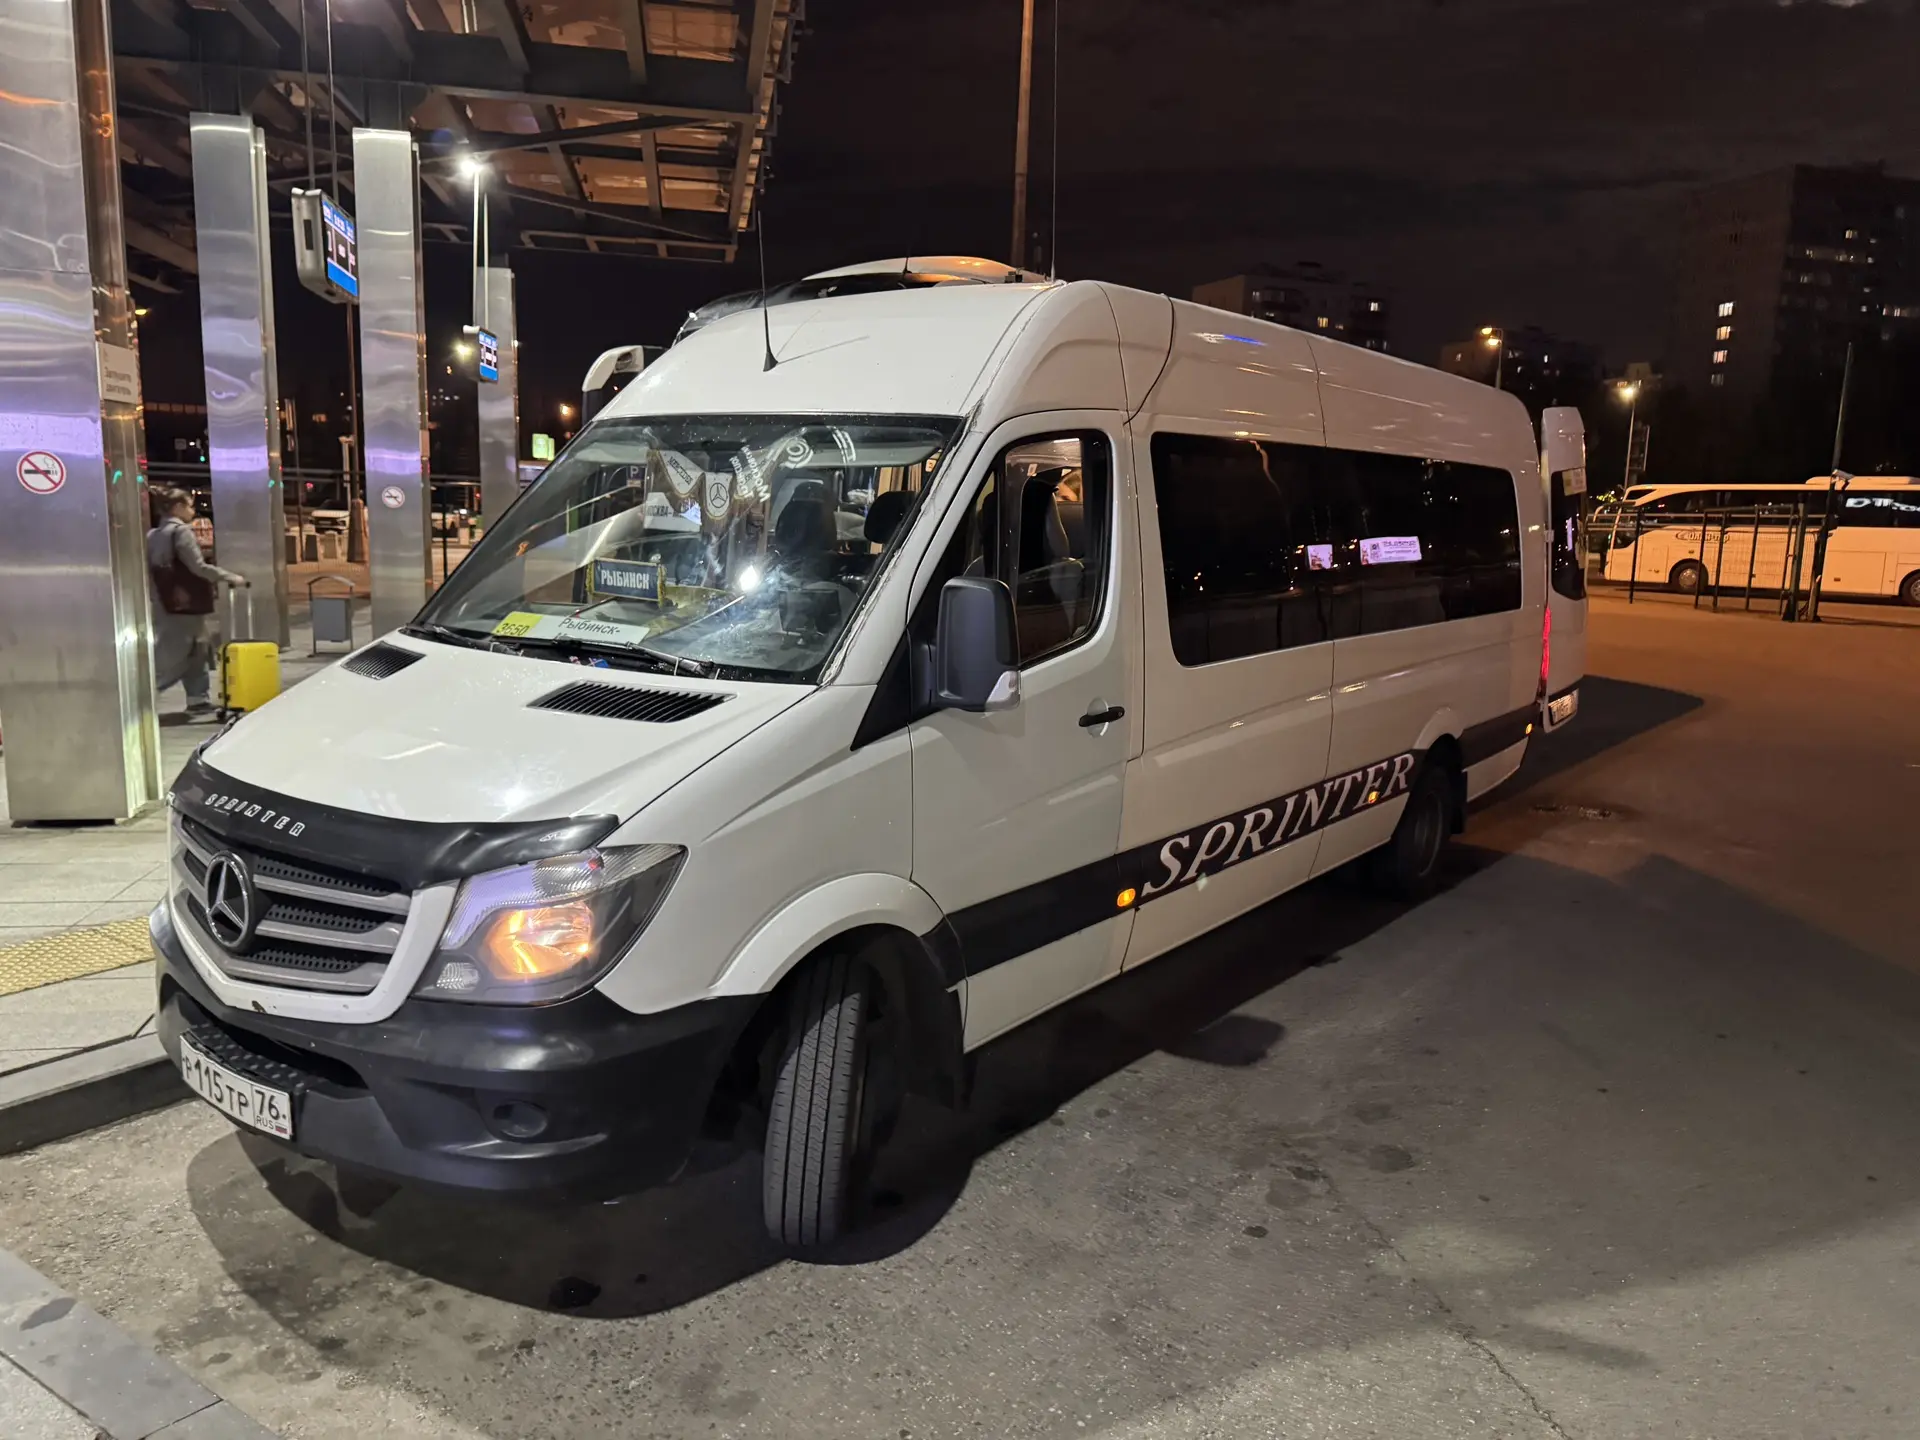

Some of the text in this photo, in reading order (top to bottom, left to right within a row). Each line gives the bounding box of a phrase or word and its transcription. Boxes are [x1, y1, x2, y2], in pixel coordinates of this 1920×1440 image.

[601, 569, 650, 590] РЫБИНСК
[498, 622, 530, 636] 3650
[204, 793, 306, 837] SPRINTER
[1141, 753, 1415, 897] SPRINTER
[256, 1115, 275, 1130] RUS
